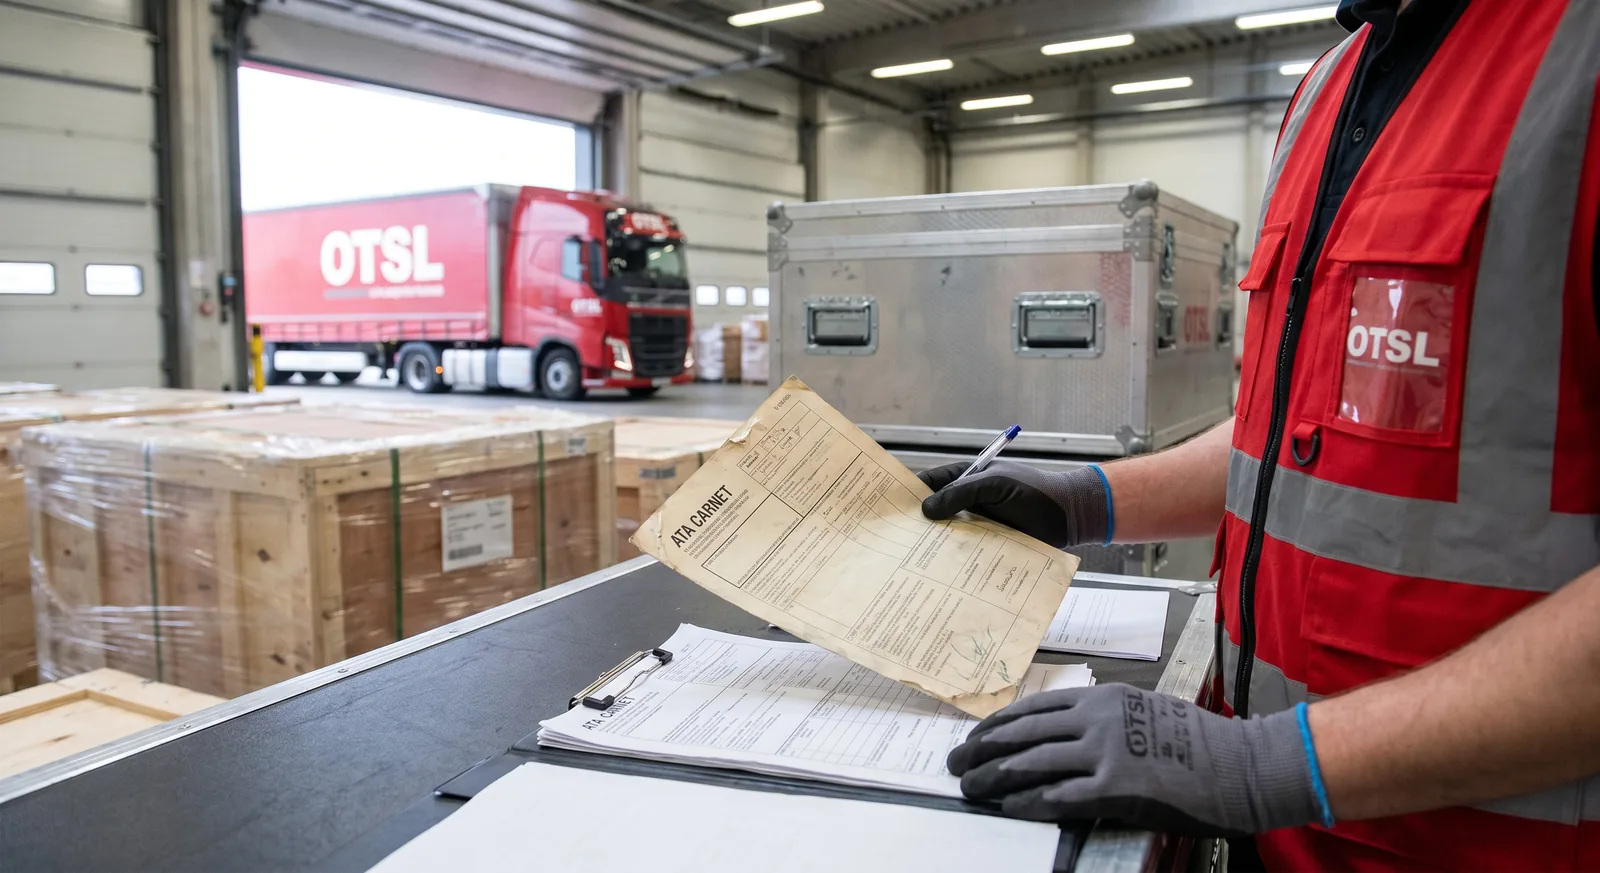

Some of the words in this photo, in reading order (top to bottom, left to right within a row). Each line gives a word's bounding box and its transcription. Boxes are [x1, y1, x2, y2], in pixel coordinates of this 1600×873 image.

[320, 225, 445, 286] OTSL
[1346, 325, 1440, 367] OTSL
[670, 524, 697, 548] ATA
[690, 484, 733, 528] CARNET
[582, 718, 605, 730] ATA
[1126, 691, 1148, 757] OTSL
